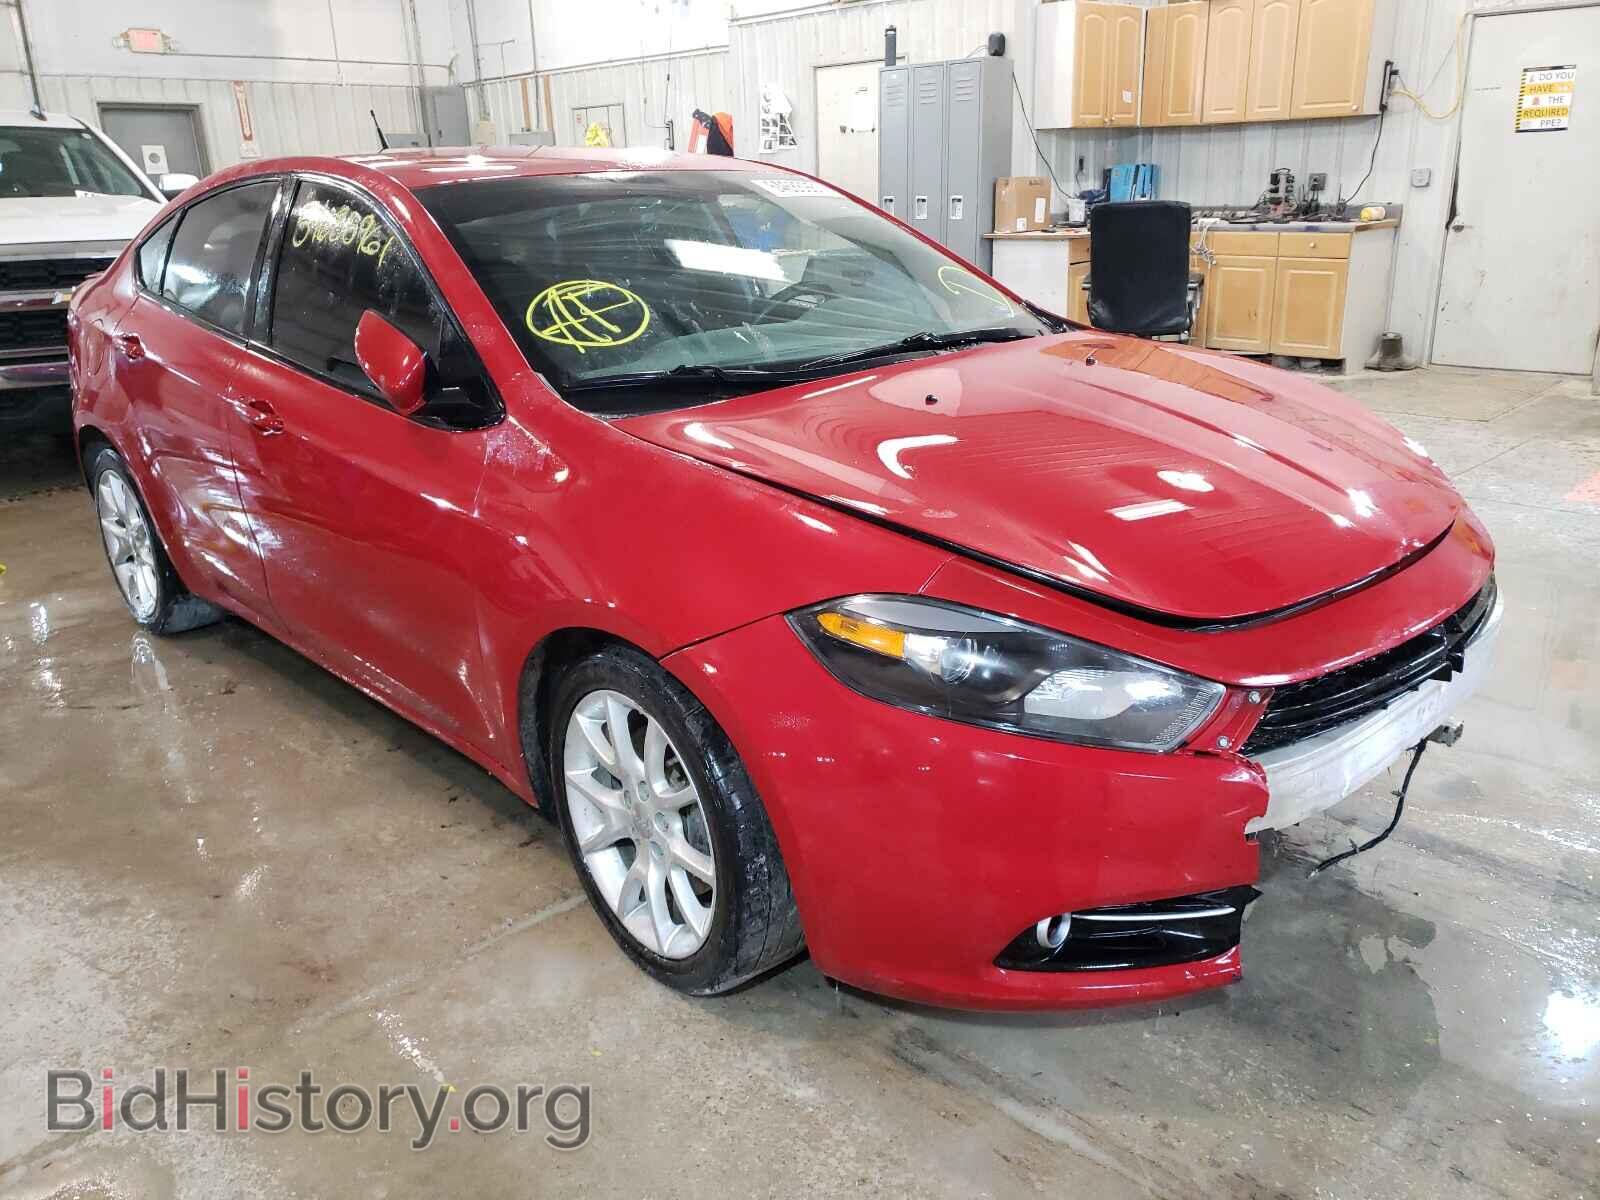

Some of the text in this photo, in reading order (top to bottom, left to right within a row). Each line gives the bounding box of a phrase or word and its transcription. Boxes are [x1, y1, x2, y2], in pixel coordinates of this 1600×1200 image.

[1539, 71, 1574, 81] DO YOU
[1529, 83, 1553, 93] HAVE
[1548, 96, 1565, 104] THE
[1523, 107, 1568, 119] REQUIRED
[1540, 118, 1562, 128] PPE?
